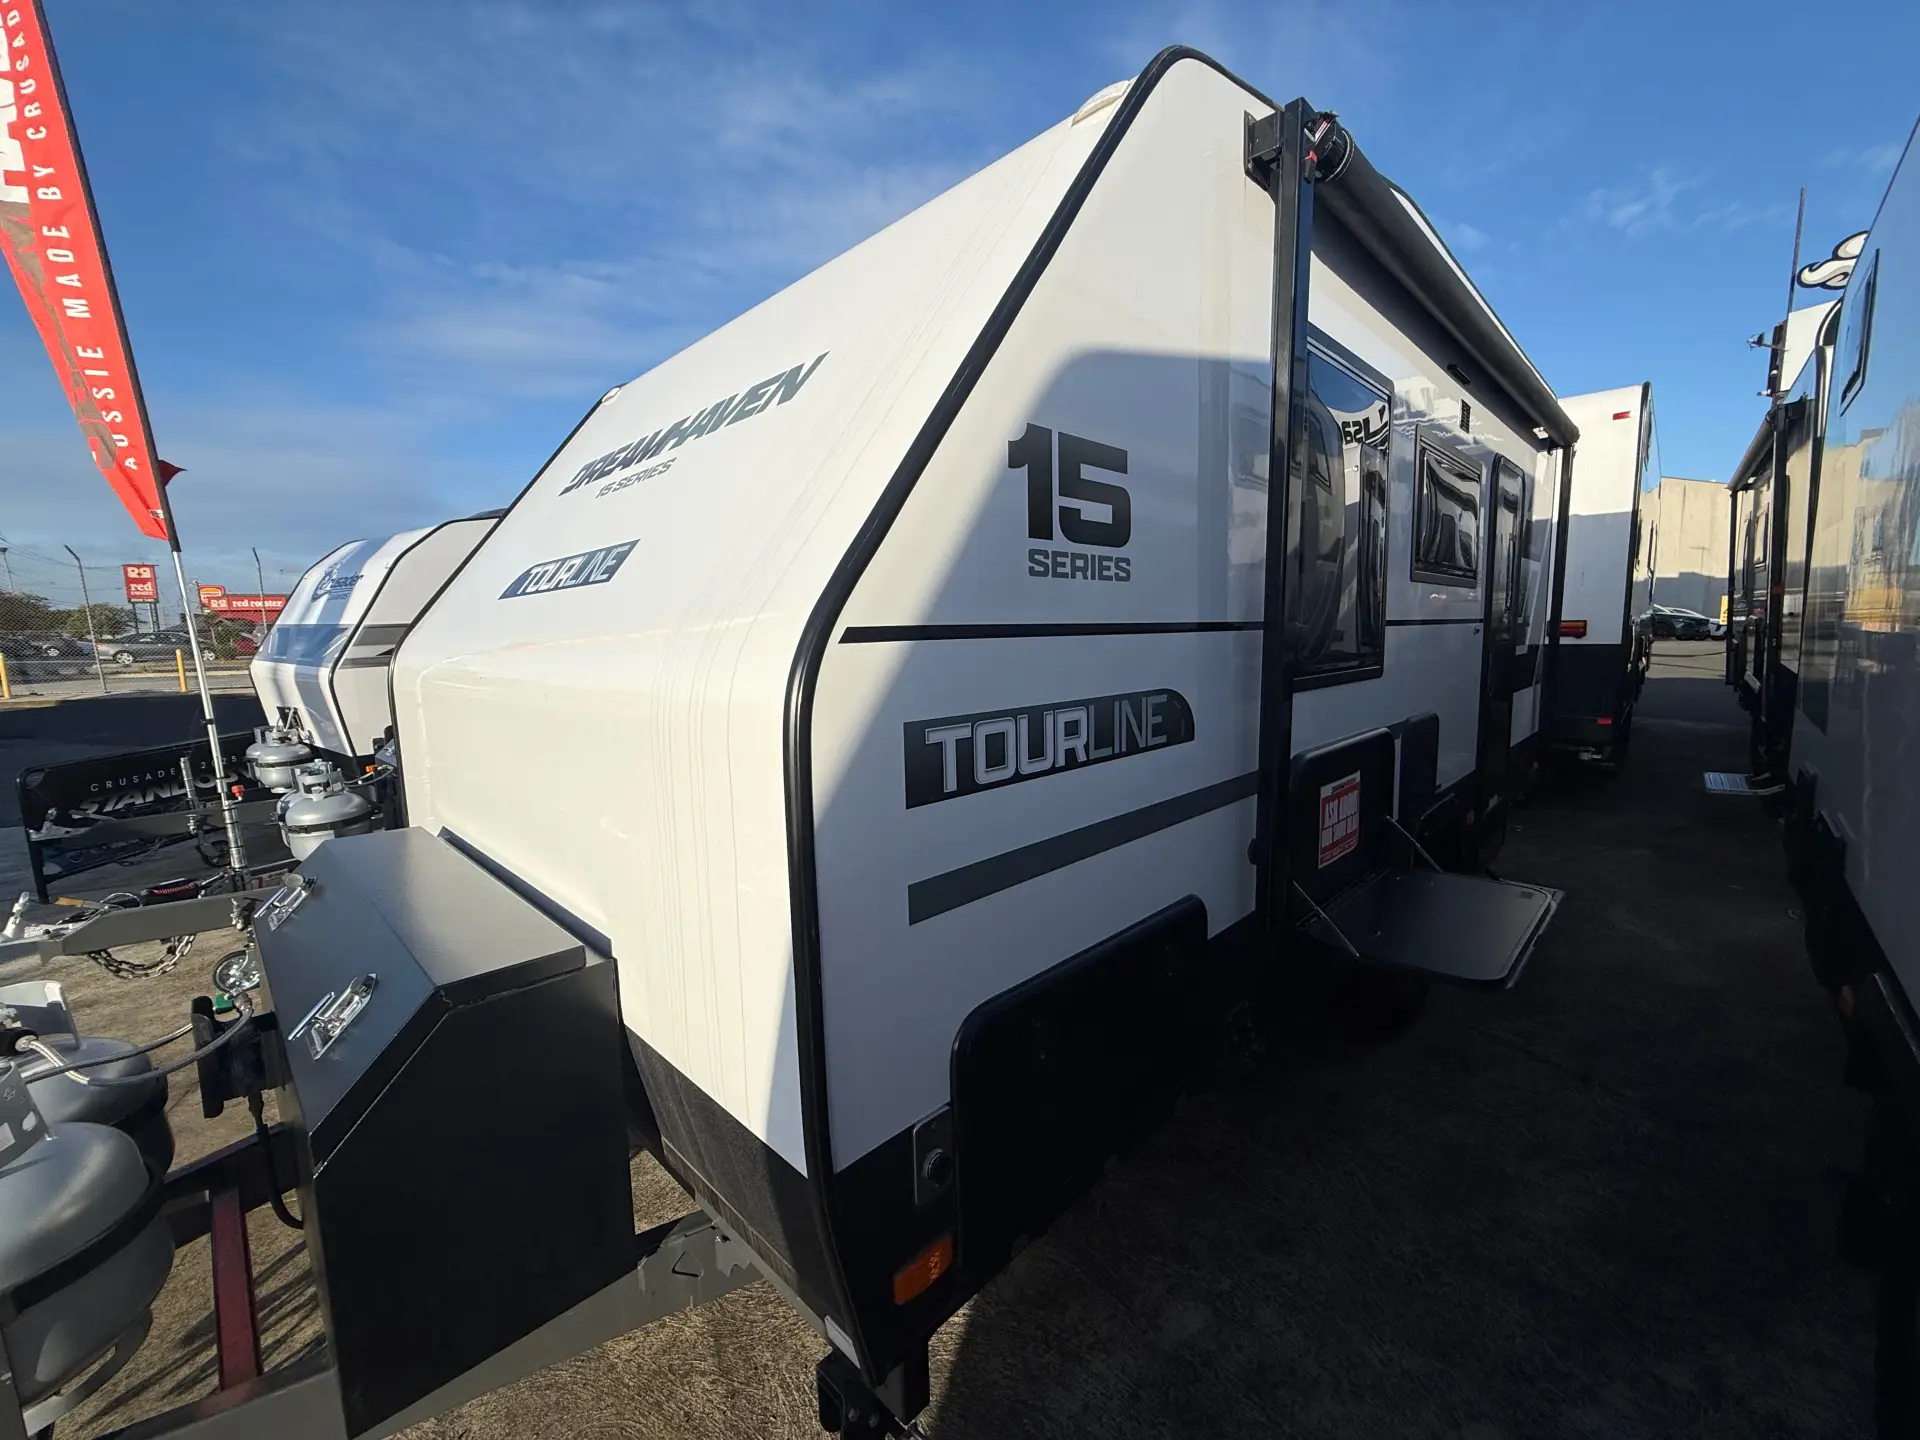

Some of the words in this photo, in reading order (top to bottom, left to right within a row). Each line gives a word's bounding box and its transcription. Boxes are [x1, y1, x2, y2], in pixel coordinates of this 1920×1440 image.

[2, 0, 47, 140] CRUSAD
[32, 165, 63, 200] BY
[42, 225, 92, 318] MADE
[76, 346, 138, 470] AUSSIE
[557, 350, 831, 498] DREAMHAVEN
[612, 457, 677, 493] SERIES
[1008, 422, 1131, 548] 15
[517, 544, 632, 595] TOURLINE
[1028, 548, 1131, 582] SERIES
[232, 599, 249, 607] red
[90, 766, 178, 792] CRUSADE
[924, 693, 1169, 793] TOURLINE
